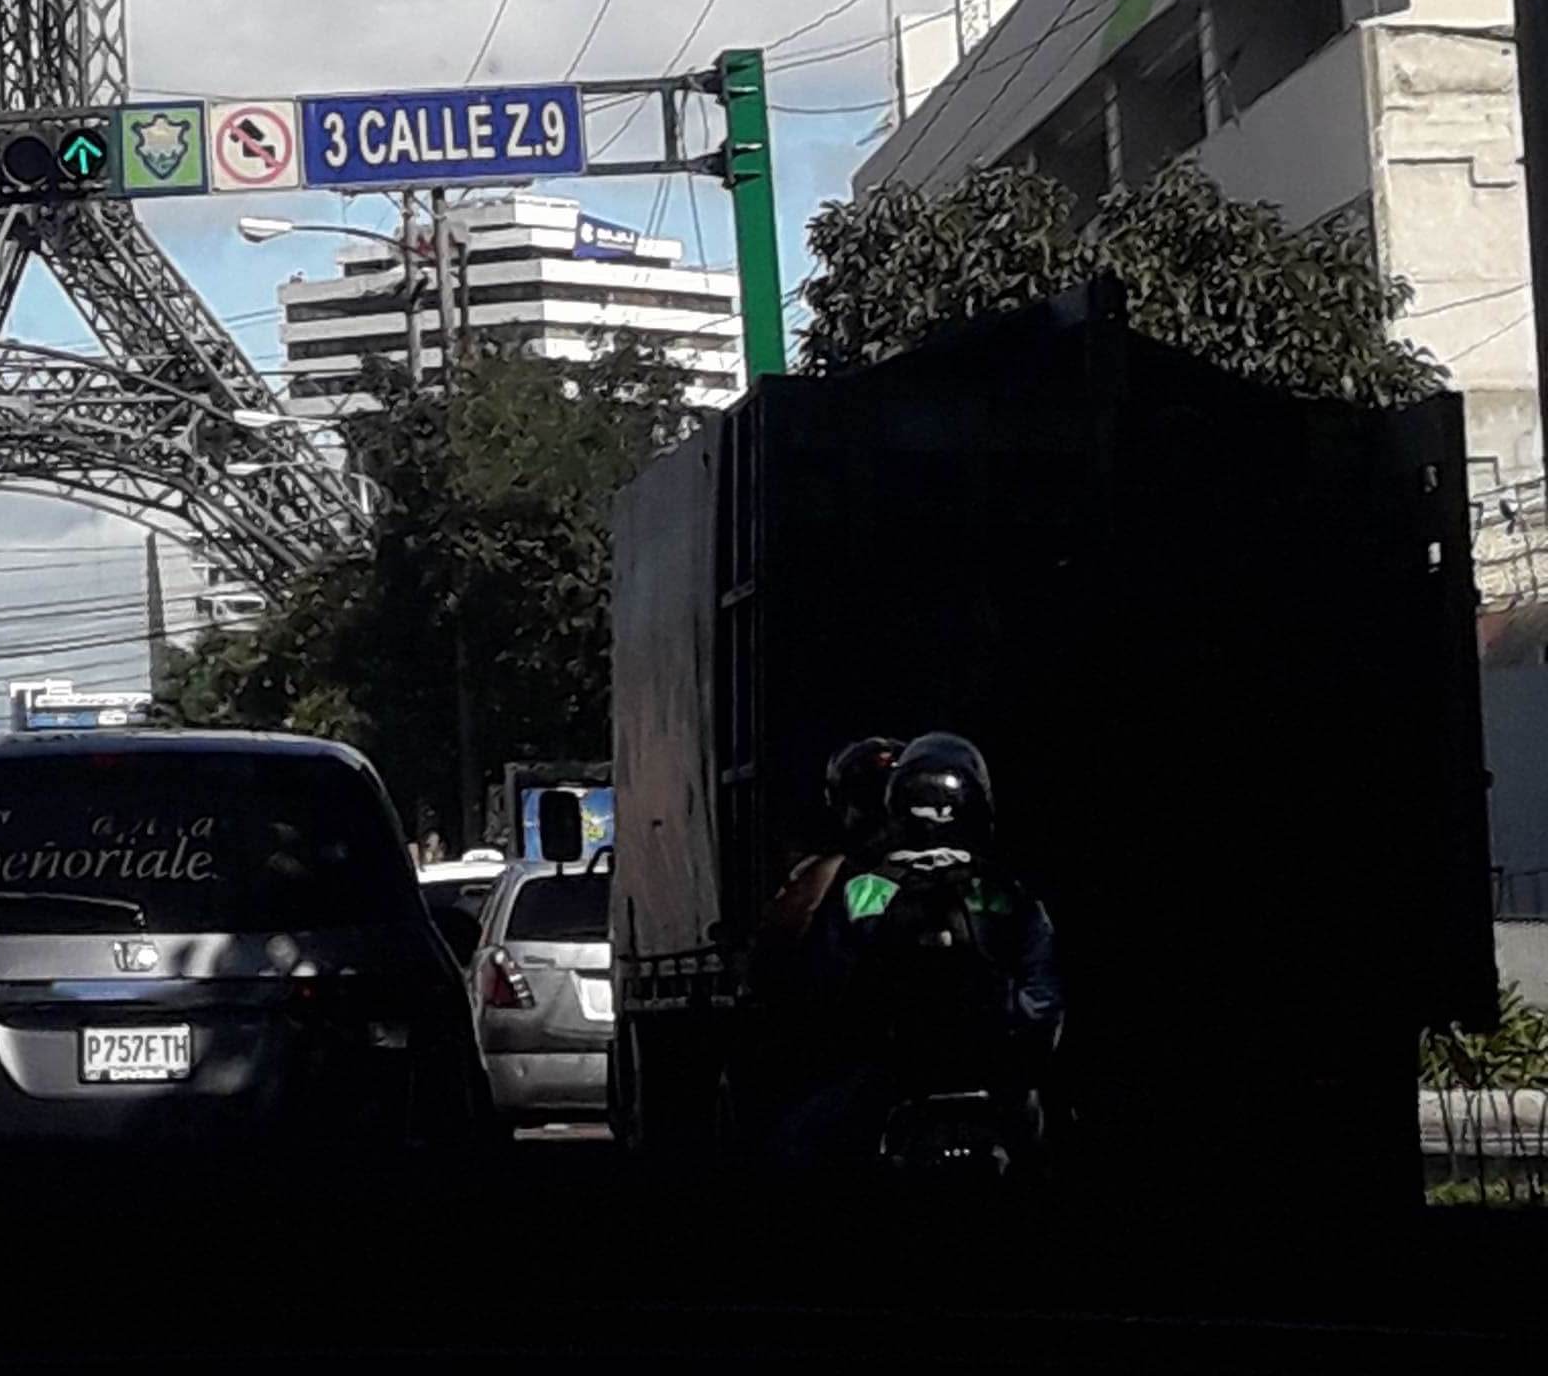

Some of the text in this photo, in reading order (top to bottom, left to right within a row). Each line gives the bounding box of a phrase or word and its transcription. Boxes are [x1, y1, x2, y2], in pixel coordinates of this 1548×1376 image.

[324, 101, 566, 167] 3 CALLE Z.9
[87, 1035, 189, 1063] P757FTH
